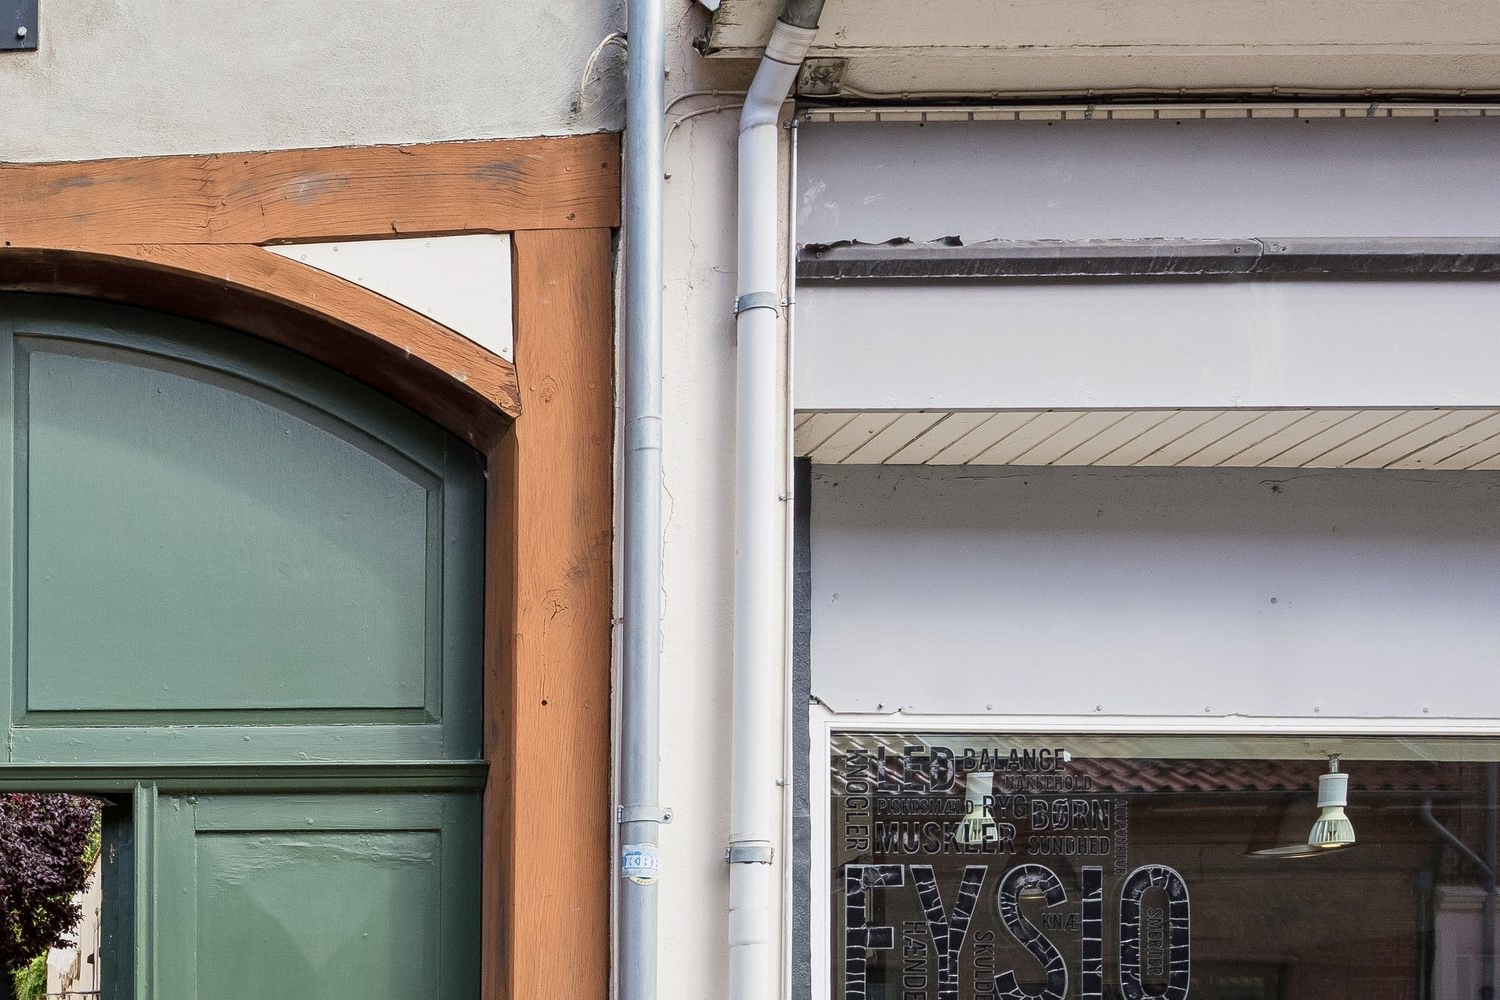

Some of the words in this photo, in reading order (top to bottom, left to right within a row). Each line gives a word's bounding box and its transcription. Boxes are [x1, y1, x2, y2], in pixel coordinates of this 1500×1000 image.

[876, 744, 955, 793] LED
[962, 747, 1067, 772] BALANCE
[1004, 774, 1093, 792] NAKKEHOLD
[844, 748, 870, 852] KNOGLER
[876, 798, 974, 816] PISKESMÆLD
[982, 793, 1028, 820] RYG
[1030, 797, 1111, 832] BØRN
[874, 821, 1017, 856] MUSKLER
[1027, 835, 1111, 856] SUNDHED
[1041, 912, 1080, 932] KNÆ
[1146, 907, 1164, 977] SMERTER
